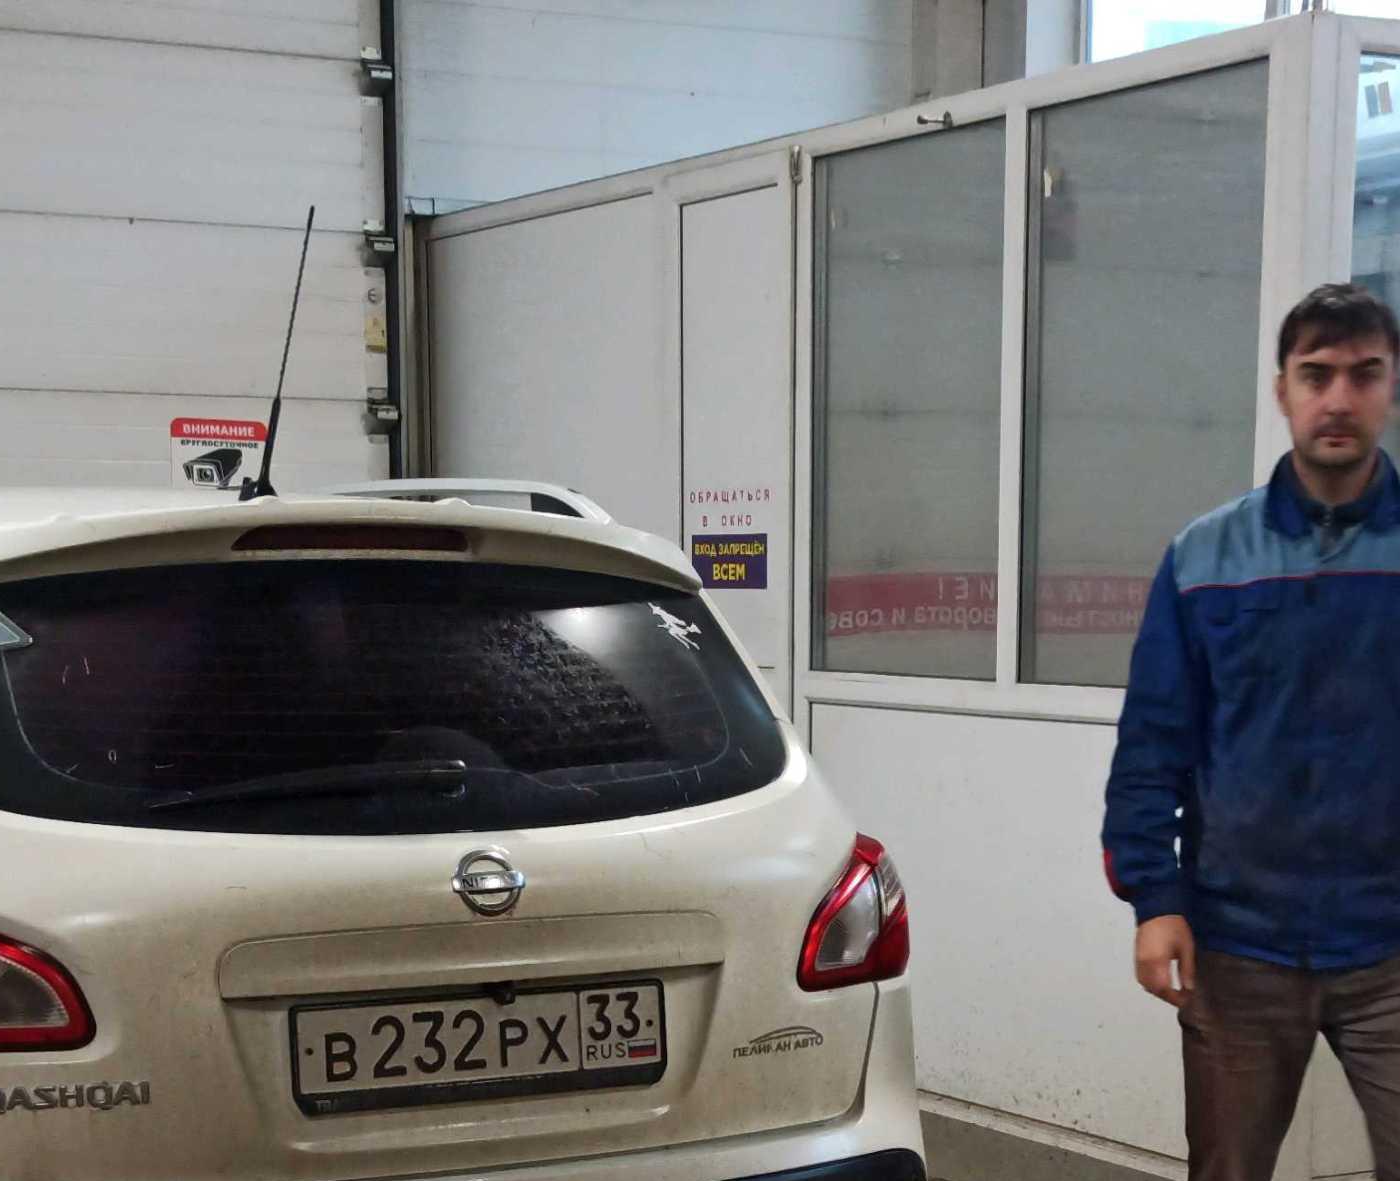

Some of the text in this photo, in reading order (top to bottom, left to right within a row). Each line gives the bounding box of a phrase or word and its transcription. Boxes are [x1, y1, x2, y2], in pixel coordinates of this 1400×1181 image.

[182, 423, 255, 437] ВНИМАНИЕ
[690, 489, 770, 504] ОБРАЩАТЬСЯ
[702, 514, 752, 527] В ОКНО
[694, 543, 716, 557] ВХОД
[712, 563, 746, 580] ВСЕМ
[586, 991, 641, 1040] 33
[586, 1041, 627, 1061] RUS
[794, 1036, 824, 1051] АВТО
